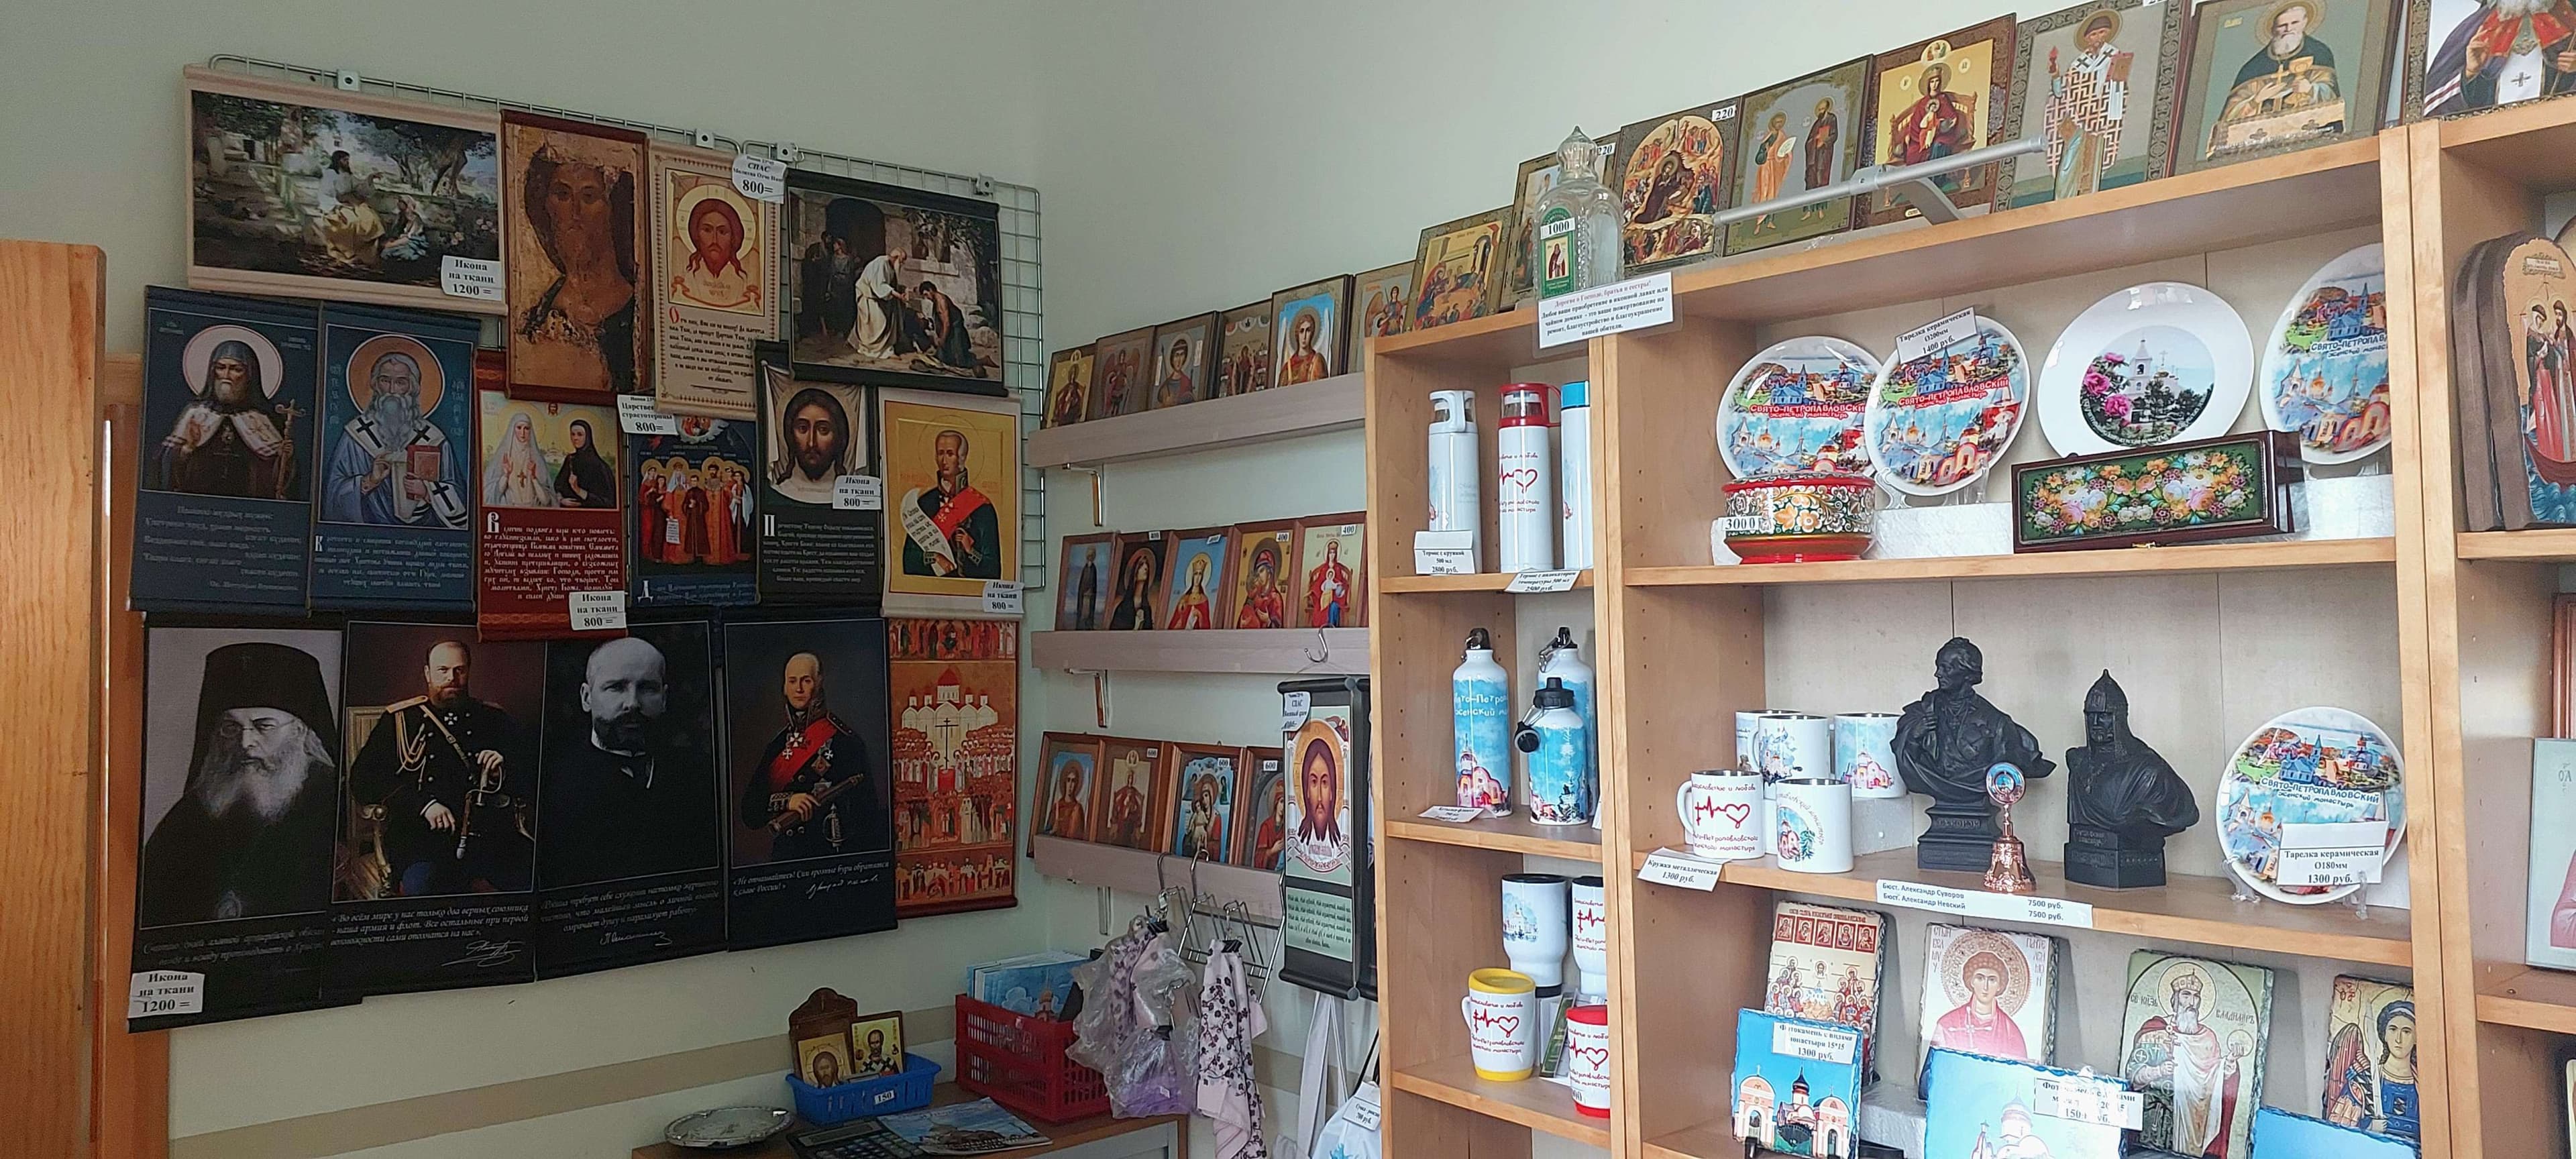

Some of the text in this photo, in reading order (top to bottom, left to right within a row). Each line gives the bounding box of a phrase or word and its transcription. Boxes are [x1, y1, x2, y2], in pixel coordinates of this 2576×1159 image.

[1715, 108, 1733, 121] 220
[1548, 221, 1570, 235] 1000
[455, 259, 488, 271] Икона
[464, 274, 494, 283] ткани
[453, 284, 480, 296] 1200
[1572, 300, 1608, 312] приобретение
[1613, 292, 1638, 302] иконной
[1638, 289, 1656, 297] лавке
[1613, 299, 1656, 311] пожертвование
[1566, 317, 1610, 331] благоустройство
[1615, 306, 1664, 321] благоукрашение
[1582, 327, 1599, 336] нашей
[1899, 310, 1971, 343] Тарелка керамическая
[1922, 335, 1955, 355] 1400 руб.
[844, 498, 860, 506] 800
[1343, 525, 1355, 533] 400
[1725, 517, 1756, 530] 3000
[582, 594, 611, 602] Икона
[992, 602, 1006, 610] 800
[584, 618, 602, 627] 800
[1218, 759, 1228, 767] 600
[1265, 761, 1276, 769] 600
[2261, 777, 2379, 804] СВЯТО-ПЕТРОПАВЛОВСКИЙ
[2278, 791, 2355, 810] женский монастырь
[2285, 849, 2379, 860] Тарелка керамическая
[1648, 859, 1717, 875] Кружка металлическая
[1662, 871, 1695, 883] 1300 руб.
[2308, 874, 2353, 885] 1300 руб.
[1882, 883, 2063, 909] Бюст. Александр Суворов 7500 руб.
[1901, 895, 1936, 906] Александр
[1937, 900, 1966, 909] Невский
[2028, 910, 2047, 919] 7500
[2047, 913, 2064, 921] руб.
[372, 912, 392, 922] мире
[417, 909, 446, 918] только
[360, 924, 388, 934] армия
[439, 917, 484, 927] остальные
[148, 973, 189, 983] Икона
[157, 986, 195, 995] ткани
[142, 999, 176, 1013] 1200
[1780, 1024, 1823, 1036] Фтокамень
[1829, 1033, 1853, 1041] видами
[1798, 1047, 1816, 1057] 1300
